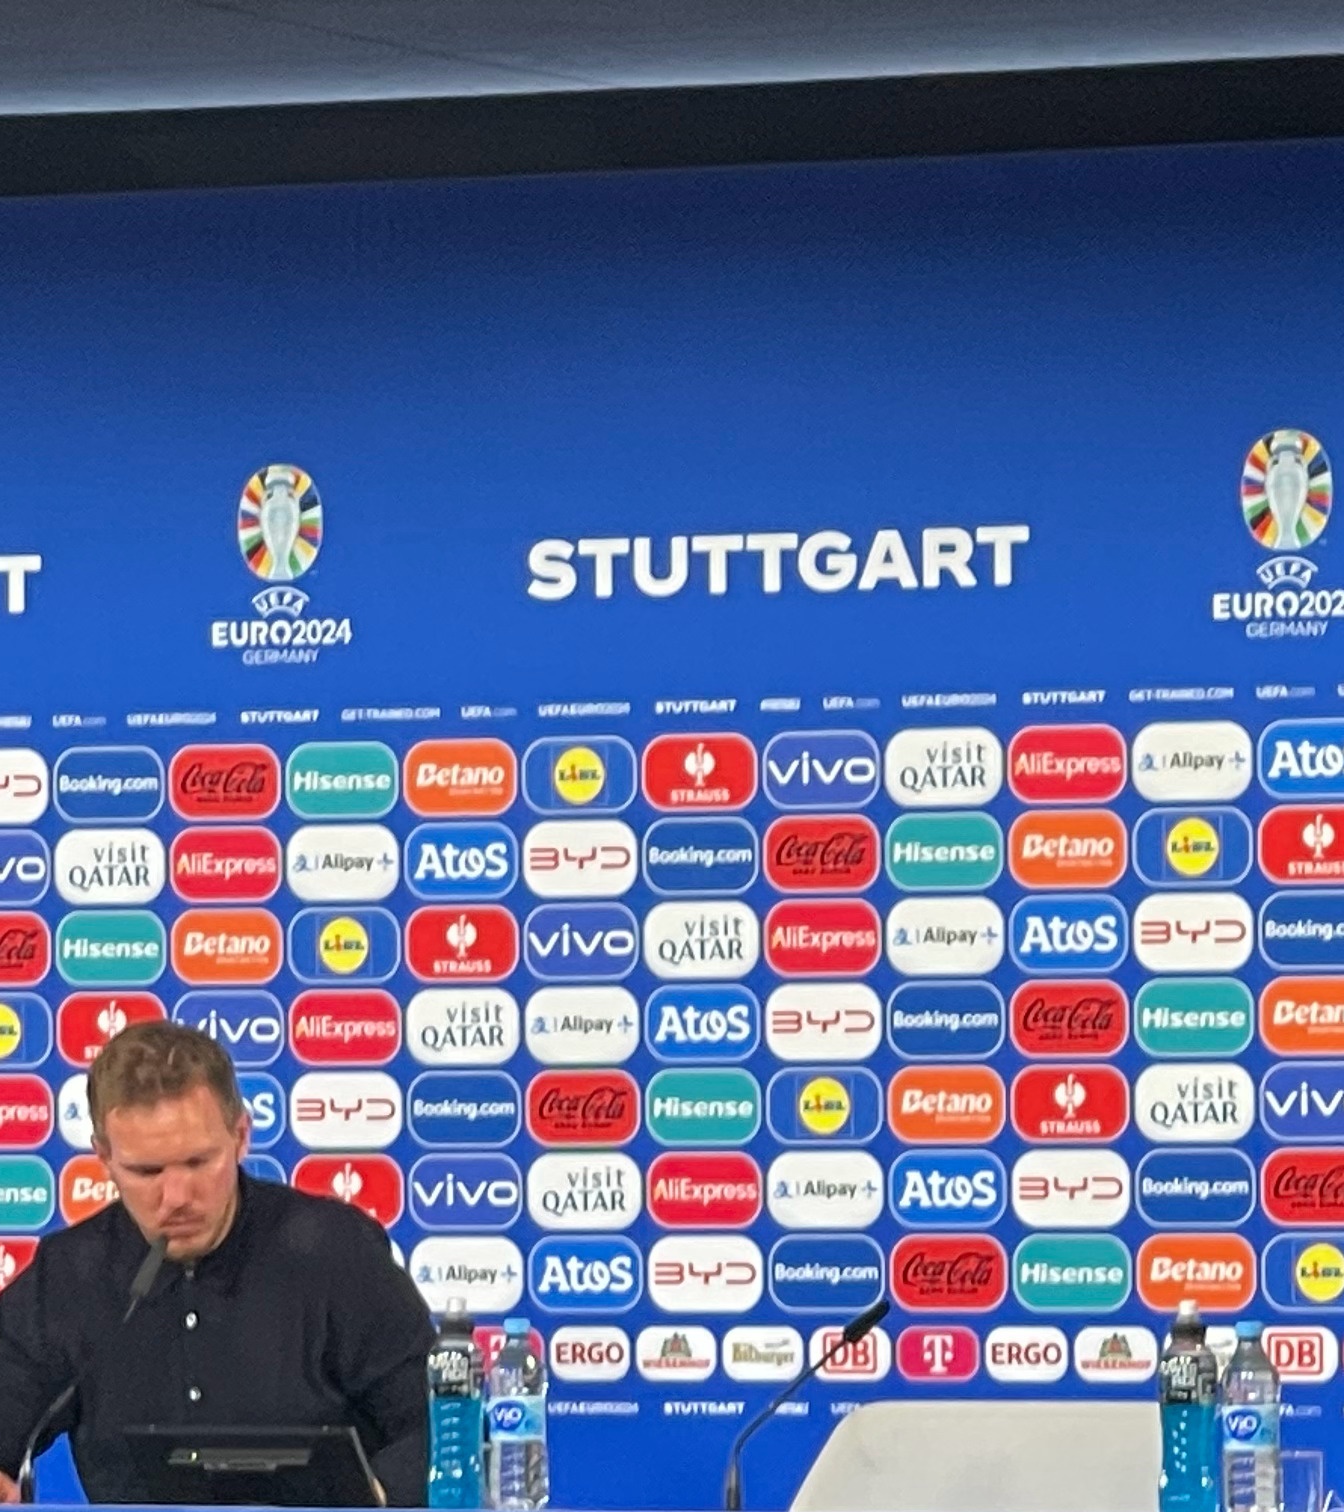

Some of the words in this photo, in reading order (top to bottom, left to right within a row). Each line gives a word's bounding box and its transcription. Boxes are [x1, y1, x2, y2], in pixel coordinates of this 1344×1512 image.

[527, 525, 1030, 601] STUTTGART
[211, 618, 353, 647] EURO2024
[1246, 621, 1328, 639] GERMANY
[242, 648, 320, 665] GERMANY
[655, 698, 738, 715] STUTTGART
[1022, 689, 1106, 706] STUTTGART
[240, 708, 319, 725] STUTTGART
[293, 769, 391, 792] Hisense
[416, 760, 504, 787] Betano
[893, 840, 996, 863] Hisense
[183, 930, 270, 955] Betano
[528, 922, 634, 956] vivo
[771, 924, 876, 954] AliExpress
[433, 959, 491, 974] STRAUSS
[445, 1000, 504, 1023] visit
[892, 1009, 998, 1032] Booking.com
[294, 1014, 396, 1043] AliExpress
[420, 1024, 504, 1050] QATAR
[1176, 1076, 1238, 1099] visit
[296, 1098, 395, 1120] BYD
[413, 1098, 515, 1120] Booking.com
[1150, 1100, 1238, 1127] QATAR
[412, 1172, 518, 1205] vivo
[653, 1177, 757, 1206] AliExpress
[654, 1262, 756, 1284] BYD
[1150, 1256, 1243, 1281] Betano
[556, 1341, 624, 1364] ERGO
[990, 1342, 1061, 1365] ERGO
[1274, 1339, 1316, 1368] DB
[663, 1401, 745, 1415] STUTTGART
